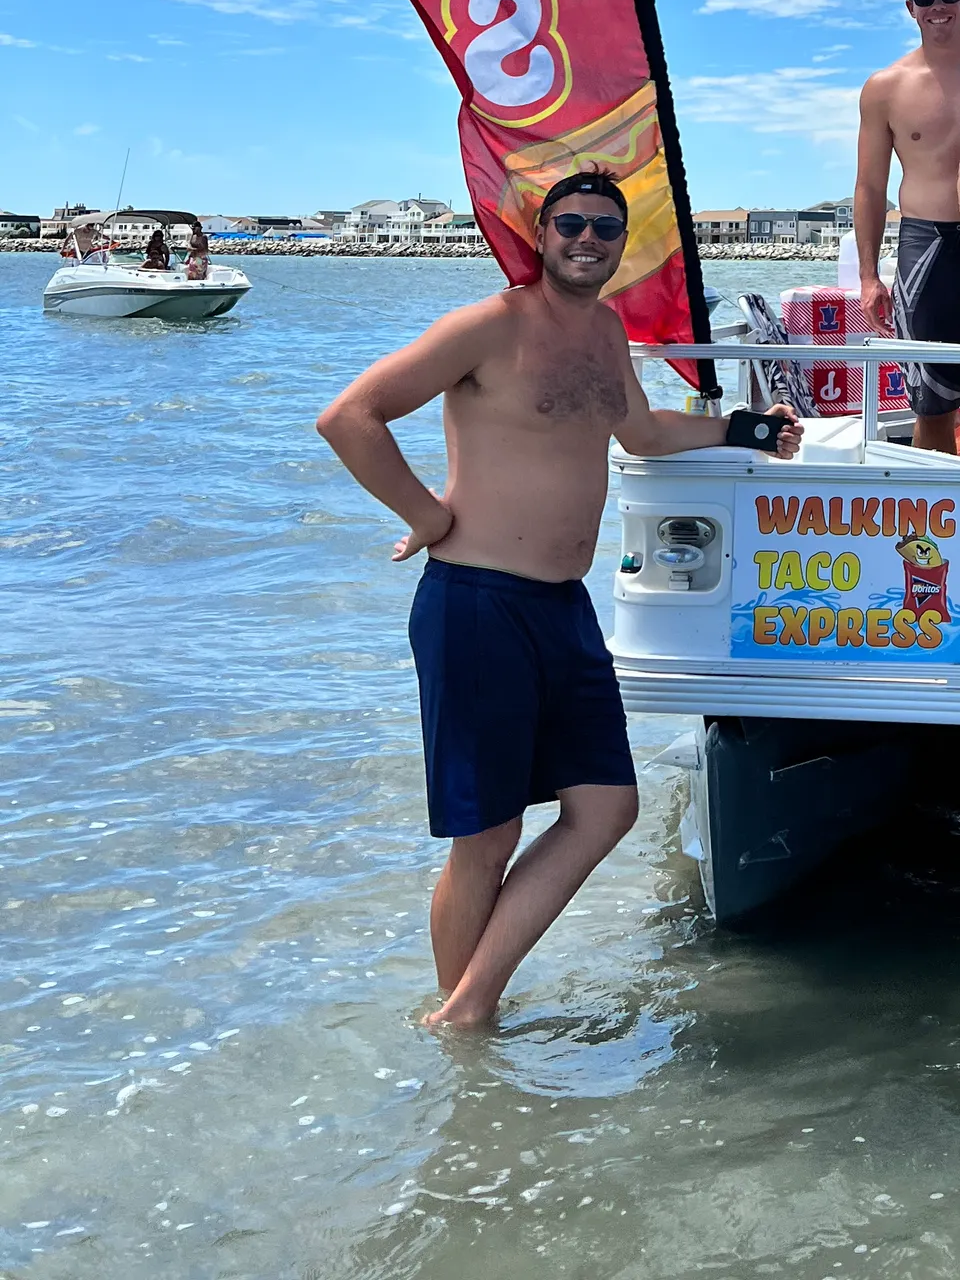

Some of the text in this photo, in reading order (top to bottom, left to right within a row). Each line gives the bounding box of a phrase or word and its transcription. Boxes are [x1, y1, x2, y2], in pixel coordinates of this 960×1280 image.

[754, 495, 956, 539] WALKING
[753, 550, 861, 591] TACO
[912, 583, 941, 595] Doritos
[752, 605, 944, 649] EXPRESS
